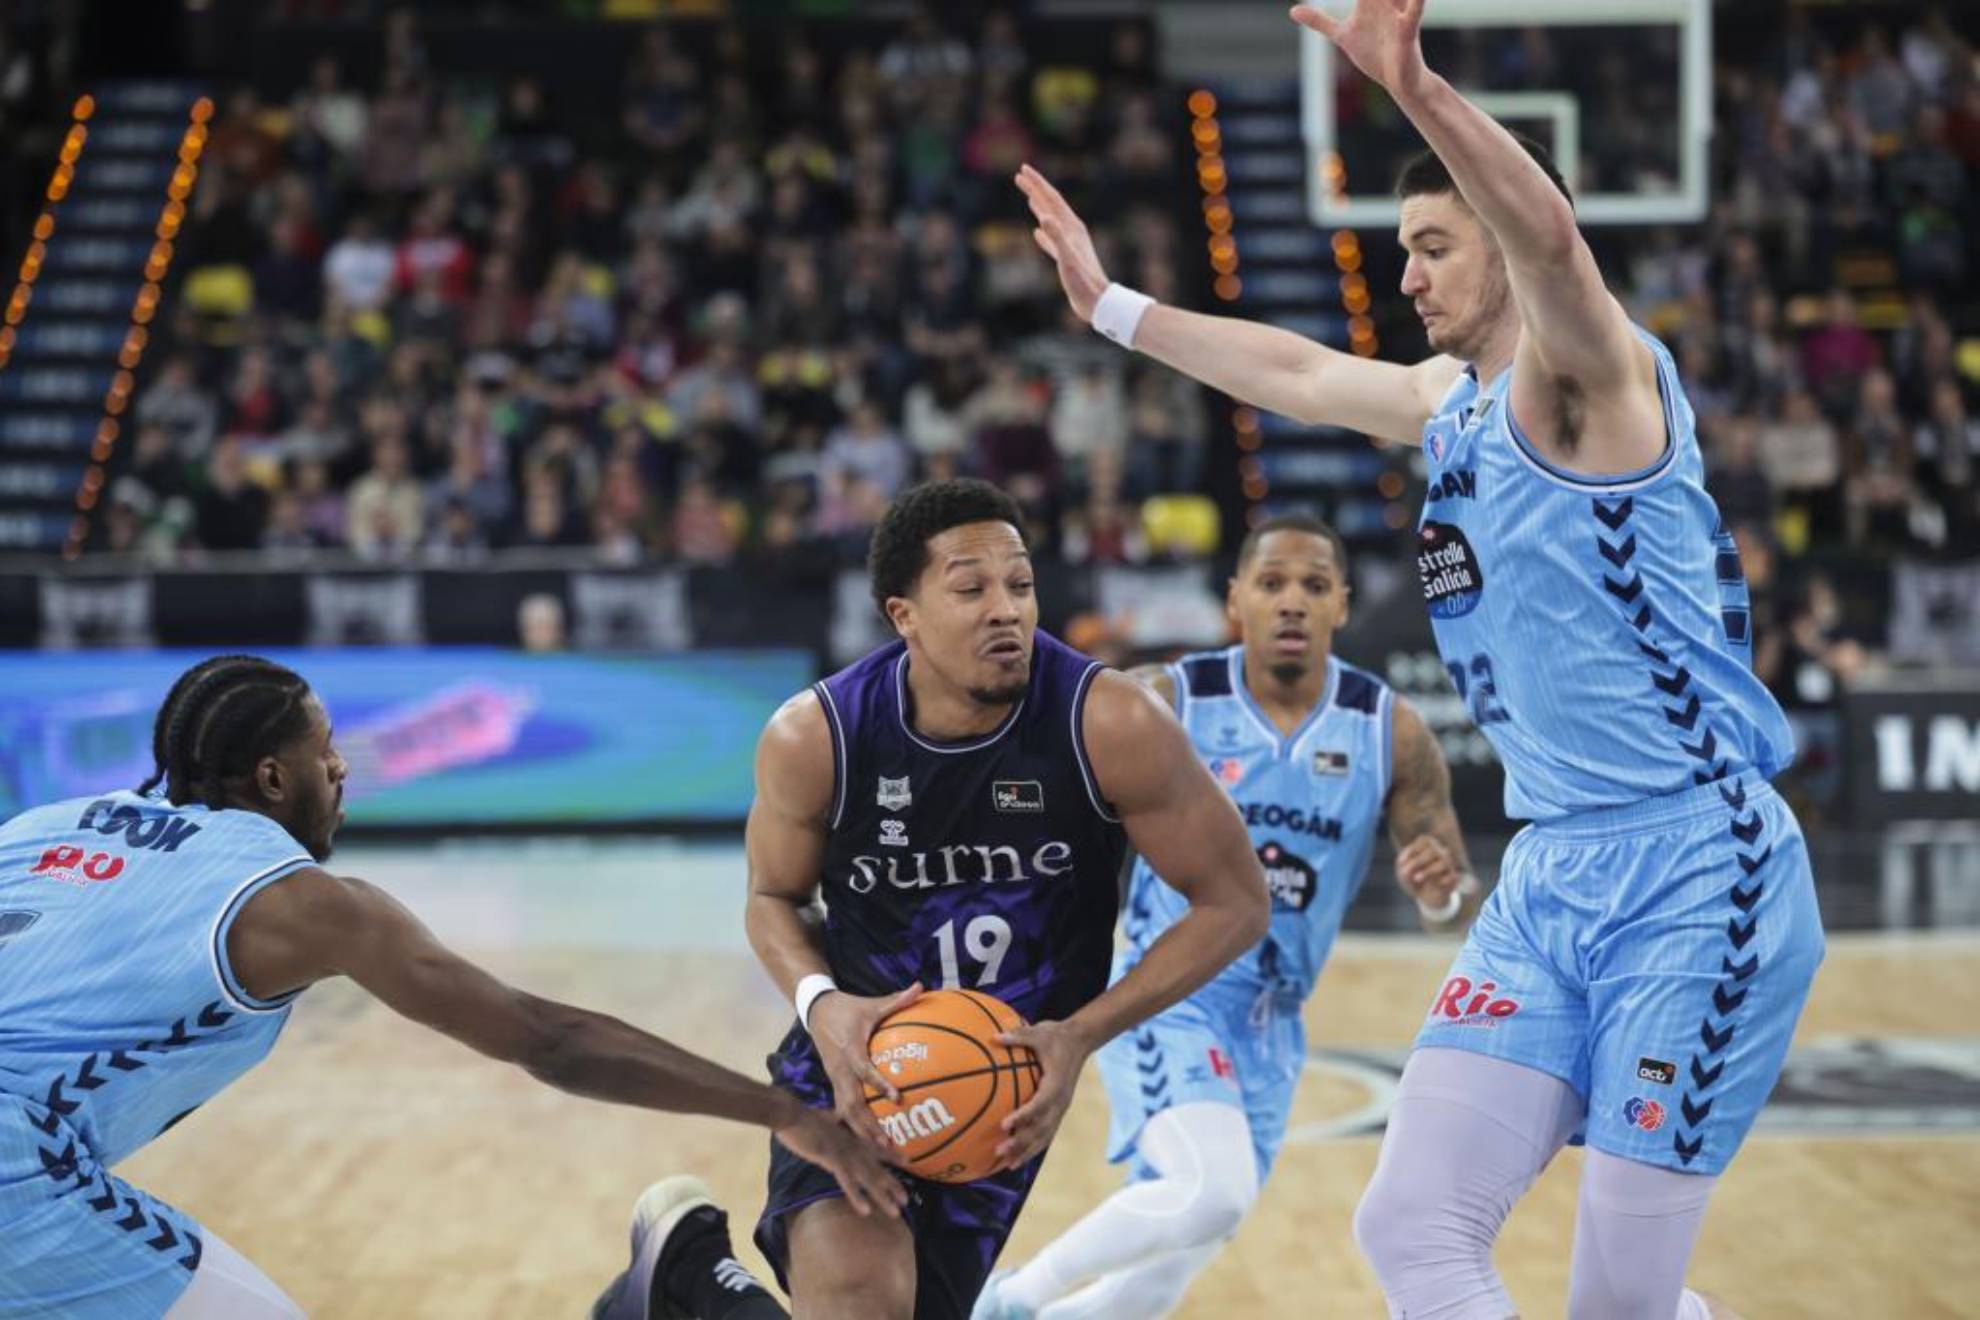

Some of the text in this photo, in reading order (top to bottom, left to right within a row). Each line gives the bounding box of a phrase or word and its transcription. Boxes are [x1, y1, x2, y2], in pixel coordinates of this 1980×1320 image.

[1418, 541, 1466, 574] strella
[849, 841, 1073, 894] surne
[931, 914, 1013, 991] 19
